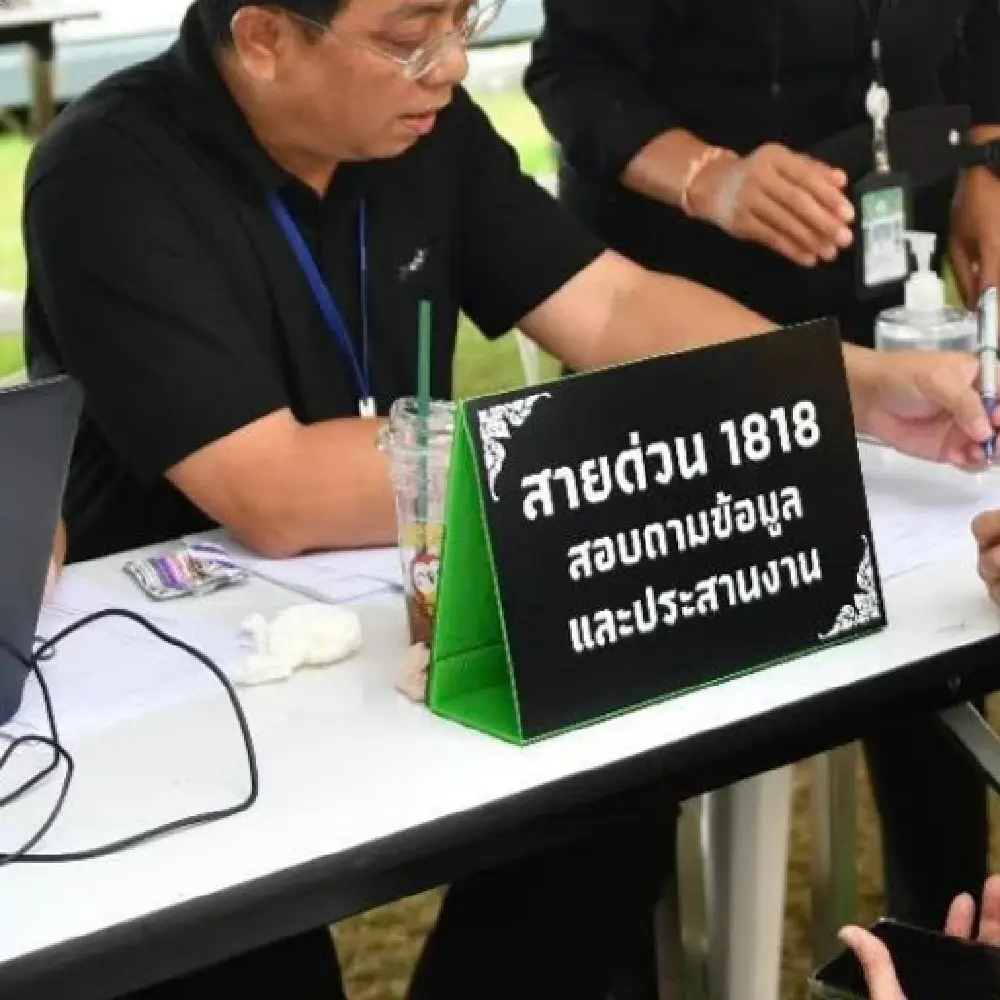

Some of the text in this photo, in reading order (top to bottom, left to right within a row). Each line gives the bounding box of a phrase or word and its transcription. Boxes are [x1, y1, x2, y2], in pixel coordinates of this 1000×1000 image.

[520, 400, 822, 521] สายด่วน 1818
[567, 486, 804, 582] สอบถามข้อมูล
[568, 548, 823, 653] และประสานงาน
